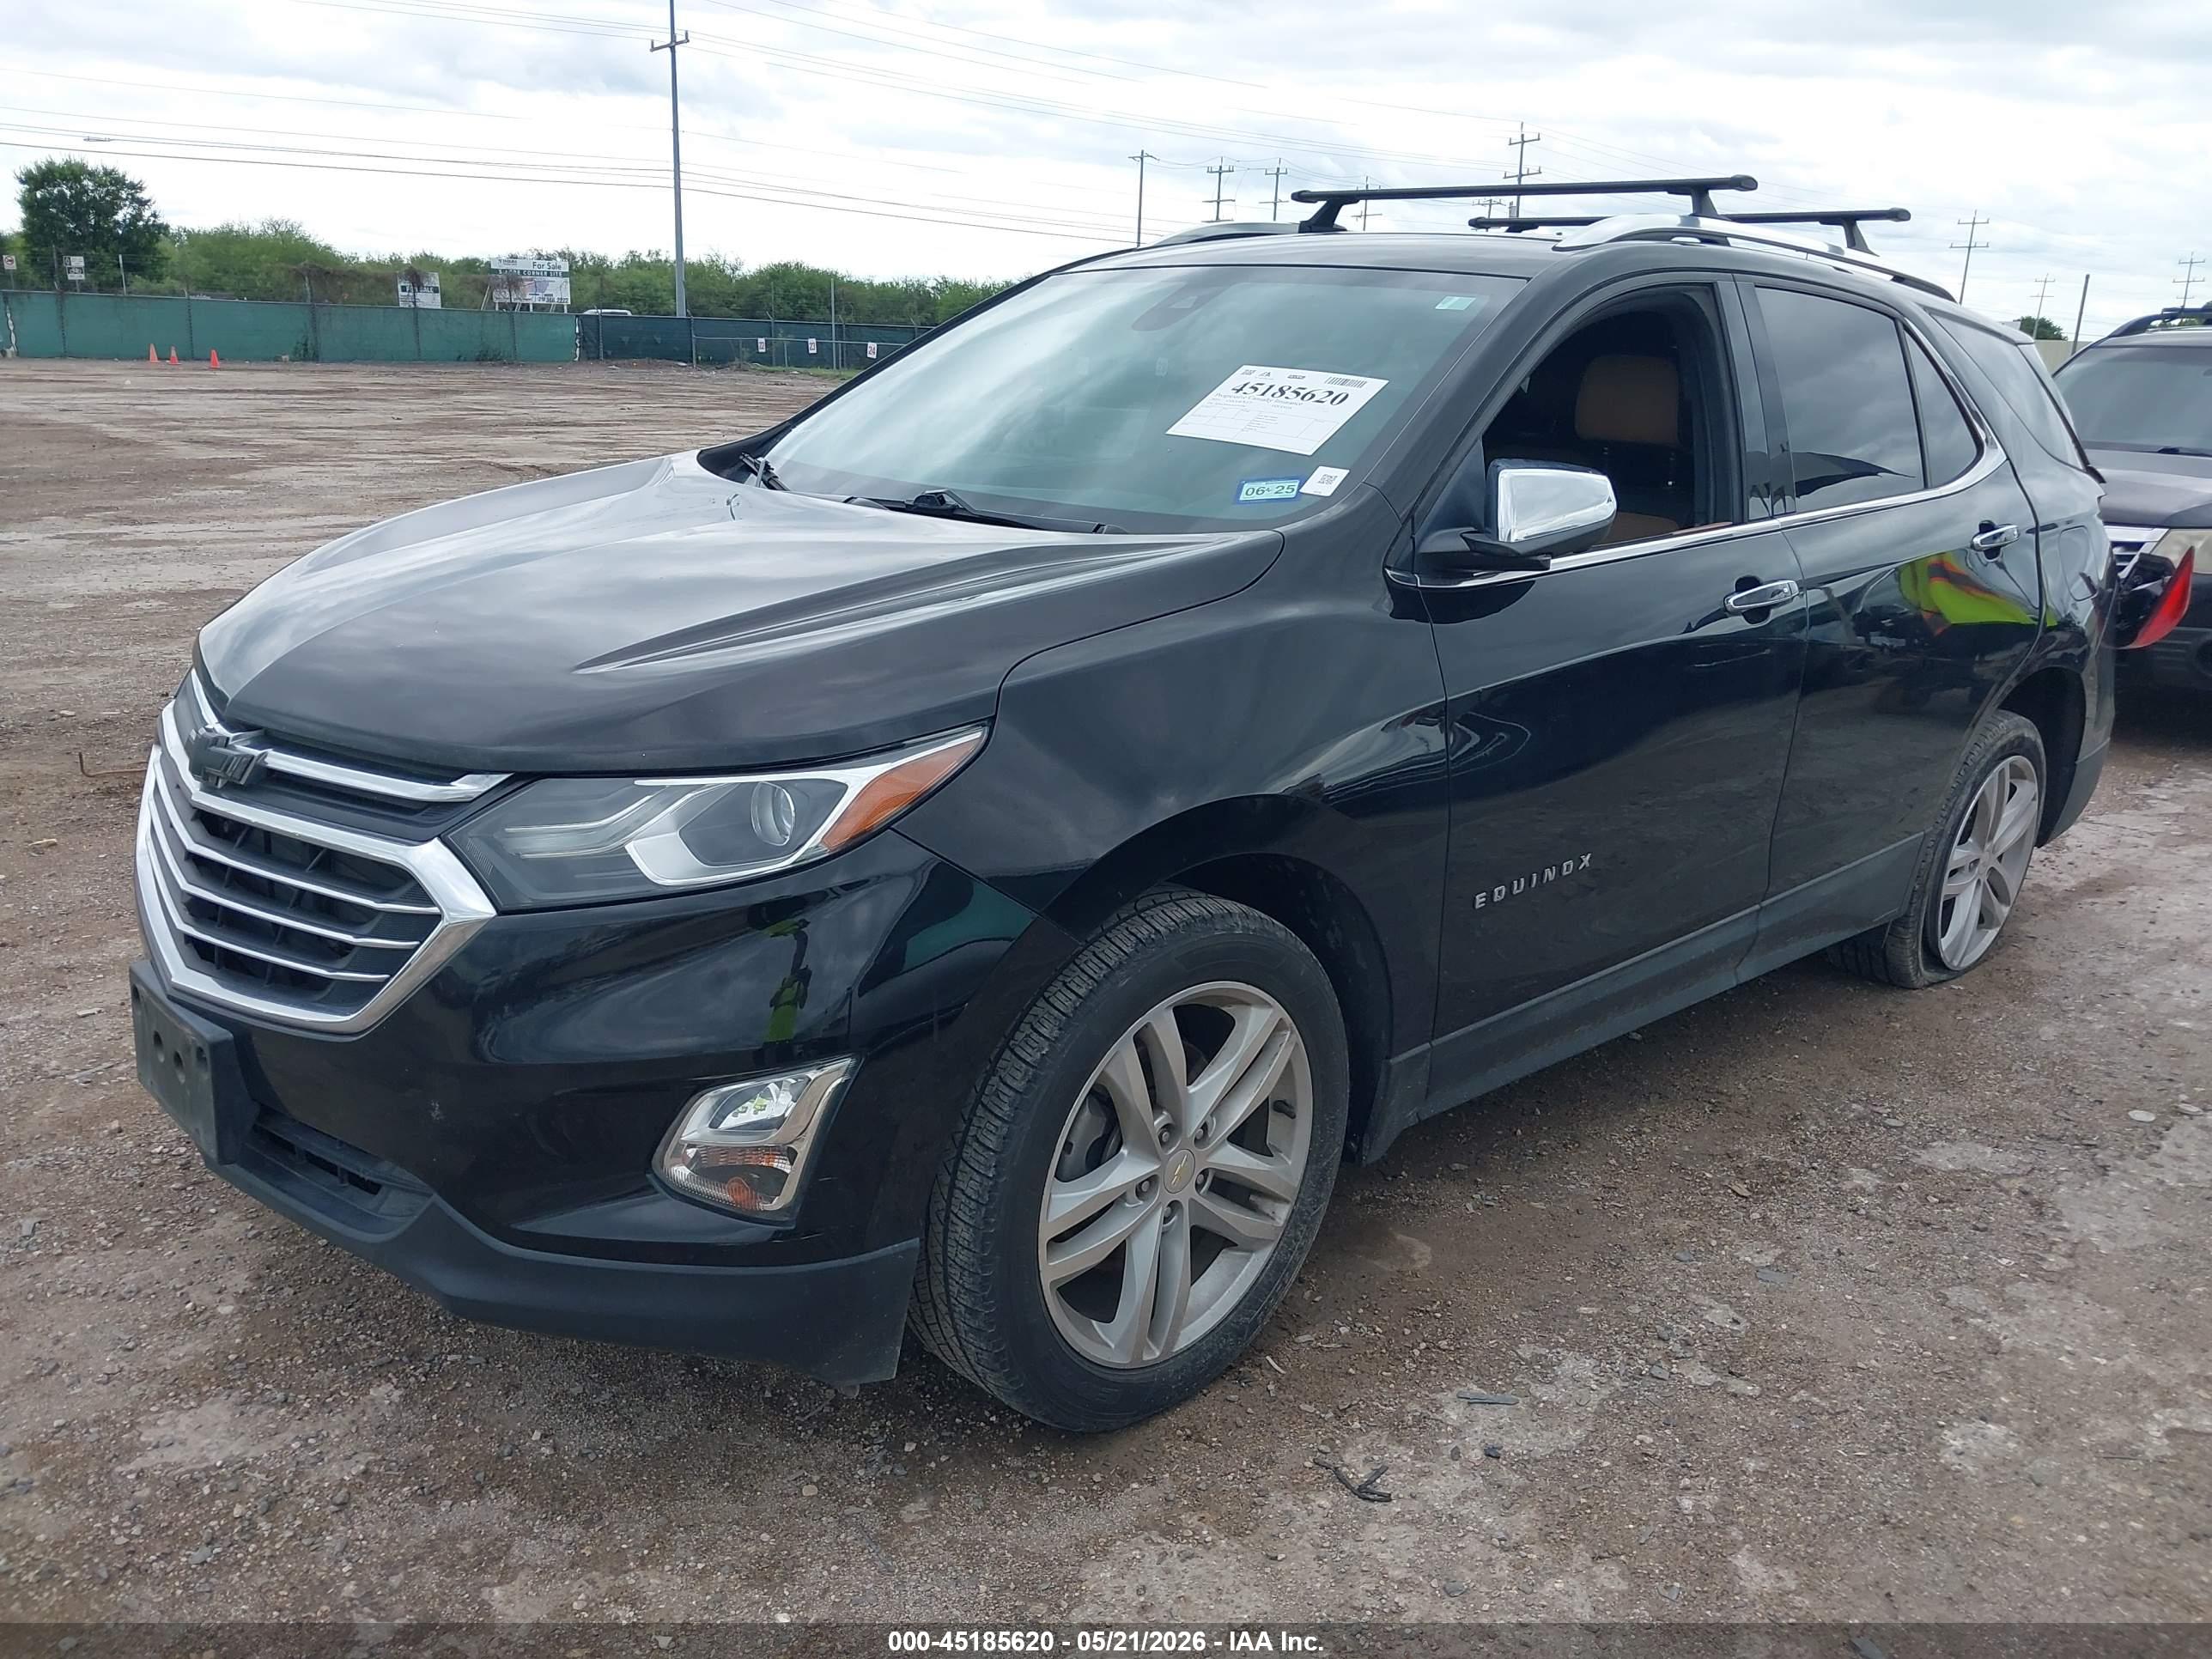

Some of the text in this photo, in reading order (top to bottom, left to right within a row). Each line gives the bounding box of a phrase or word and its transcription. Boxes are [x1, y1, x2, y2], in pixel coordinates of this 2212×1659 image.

[532, 261, 545, 270] For
[810, 342, 816, 351] 23
[868, 346, 876, 356] 24
[1231, 381, 1349, 406] 45185620
[1245, 484, 1296, 496] 06 25
[1474, 853, 1592, 910] EQUINOX
